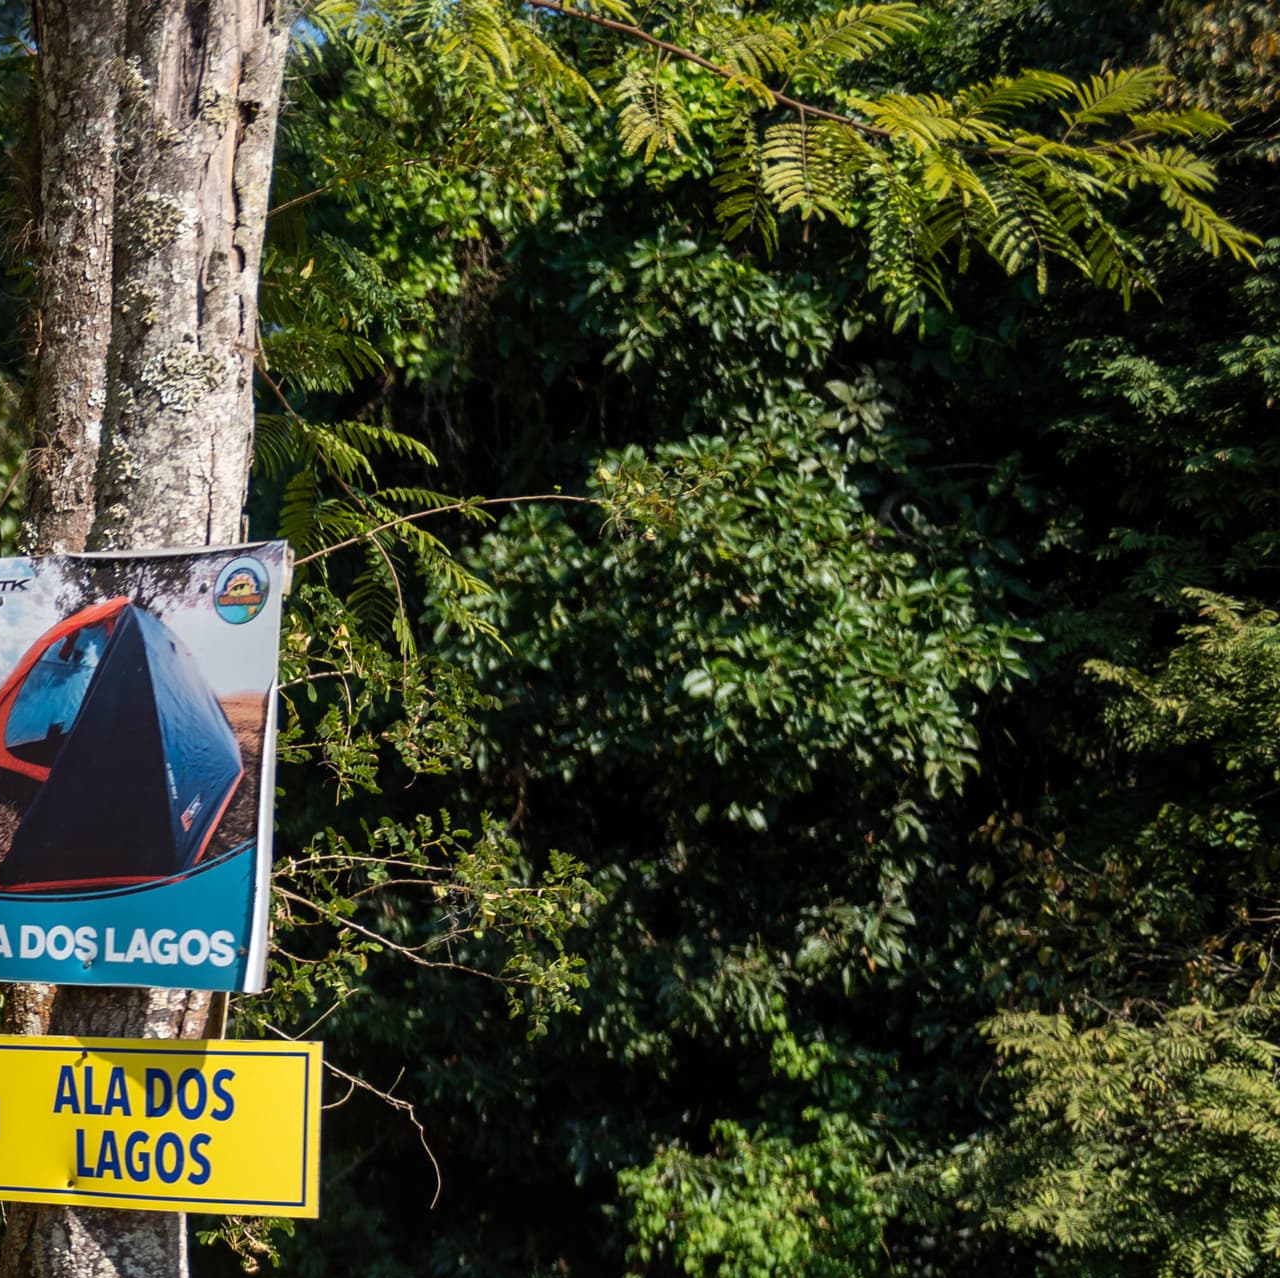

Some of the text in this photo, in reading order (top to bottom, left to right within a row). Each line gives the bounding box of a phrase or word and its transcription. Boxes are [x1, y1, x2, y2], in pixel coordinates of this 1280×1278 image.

[20, 925, 98, 962] DOS
[104, 927, 236, 967] LAGOS
[53, 1065, 236, 1121] ALA DOS
[75, 1128, 213, 1186] LAGOS
